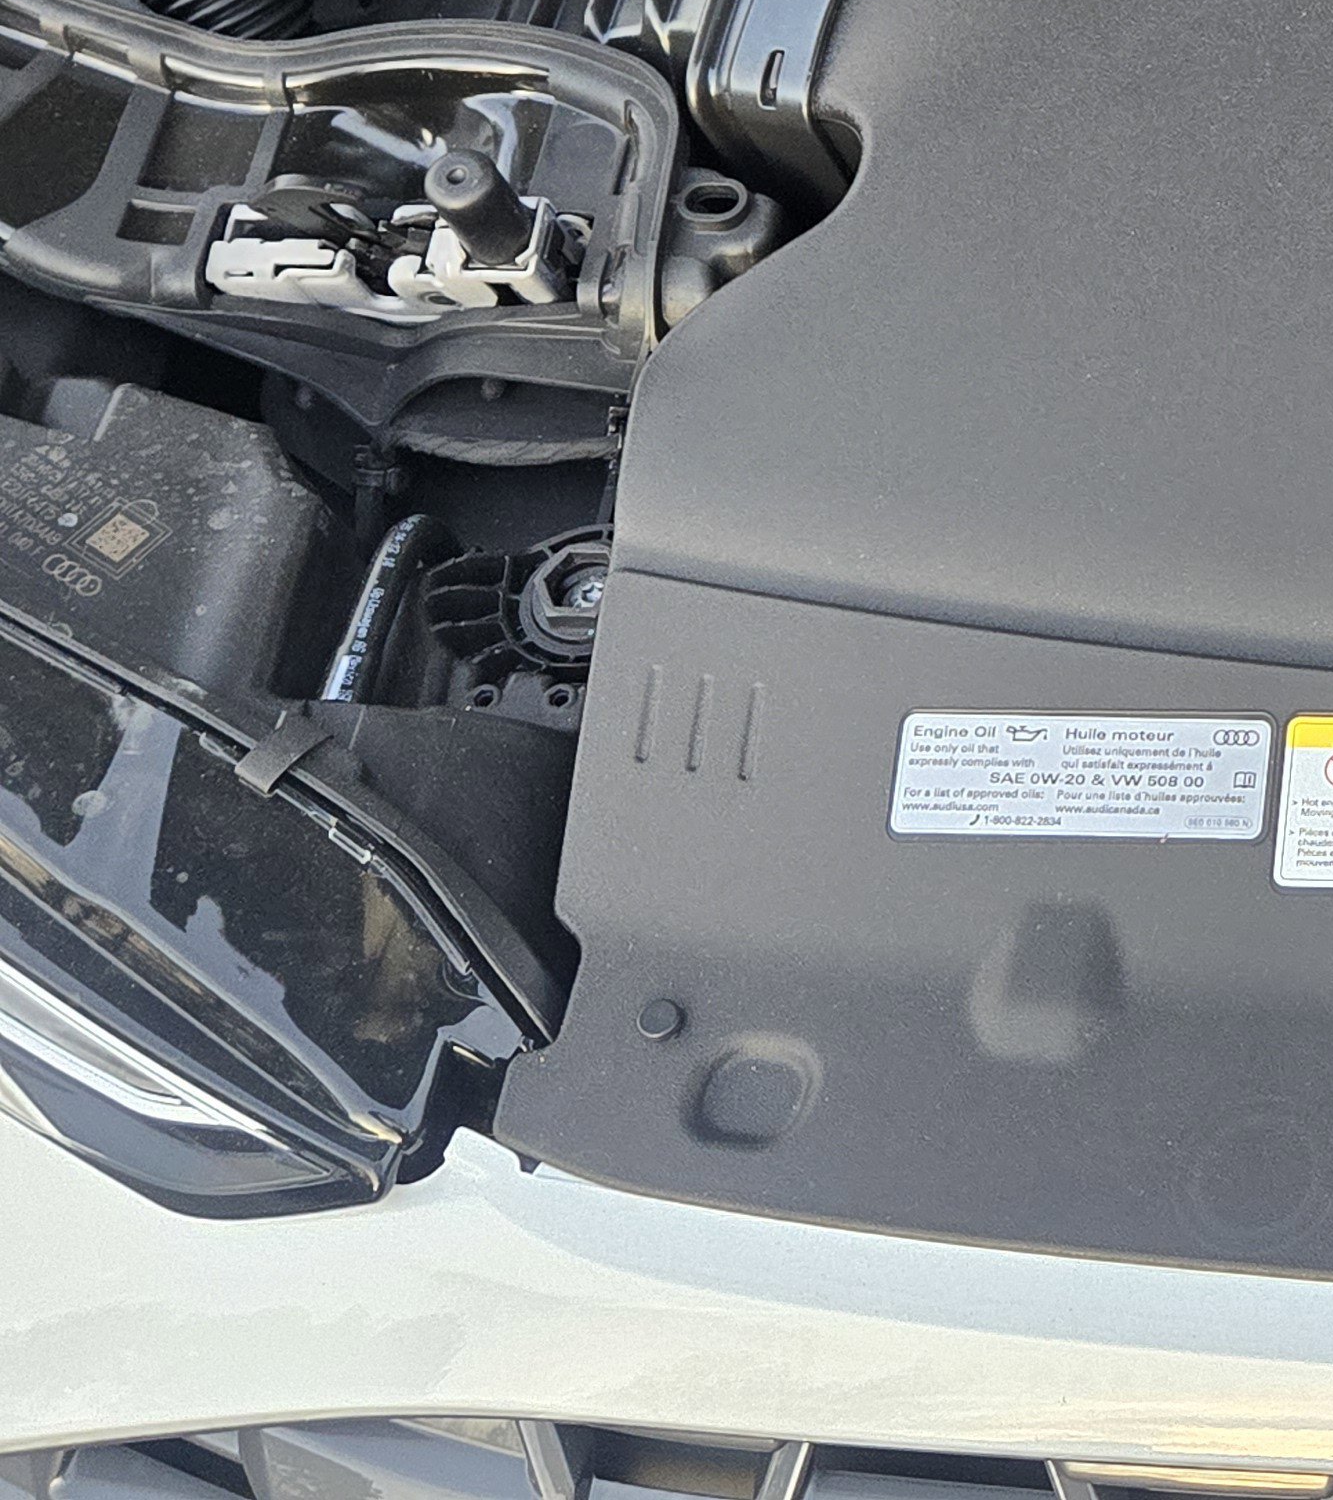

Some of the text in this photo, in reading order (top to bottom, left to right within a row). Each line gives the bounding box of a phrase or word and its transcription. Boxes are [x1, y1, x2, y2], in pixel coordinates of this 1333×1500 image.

[914, 726, 996, 738] Engine Oil
[1066, 728, 1174, 741] Huile moteur
[911, 743, 999, 754] Use only oil that
[1063, 745, 1221, 758] Utilisez uniquement de l'huile
[909, 757, 1035, 768] expressly complies with
[1062, 760, 1078, 770] qui
[1082, 760, 1124, 770] satisfait
[1127, 761, 1203, 772] expressément
[990, 772, 1203, 787] SAE 0W-20 & VW 508 00
[904, 788, 922, 798] For
[934, 788, 950, 798] list
[953, 788, 964, 798] of
[967, 788, 1018, 800] approved
[1021, 789, 1044, 799] oils:
[1057, 790, 1245, 803] Pour une liste d'huiles approuvées:
[902, 802, 999, 811] www.audiusa.com
[1056, 805, 1159, 815] www.audicanada.ca
[985, 816, 1061, 826] 1-800-822-2834
